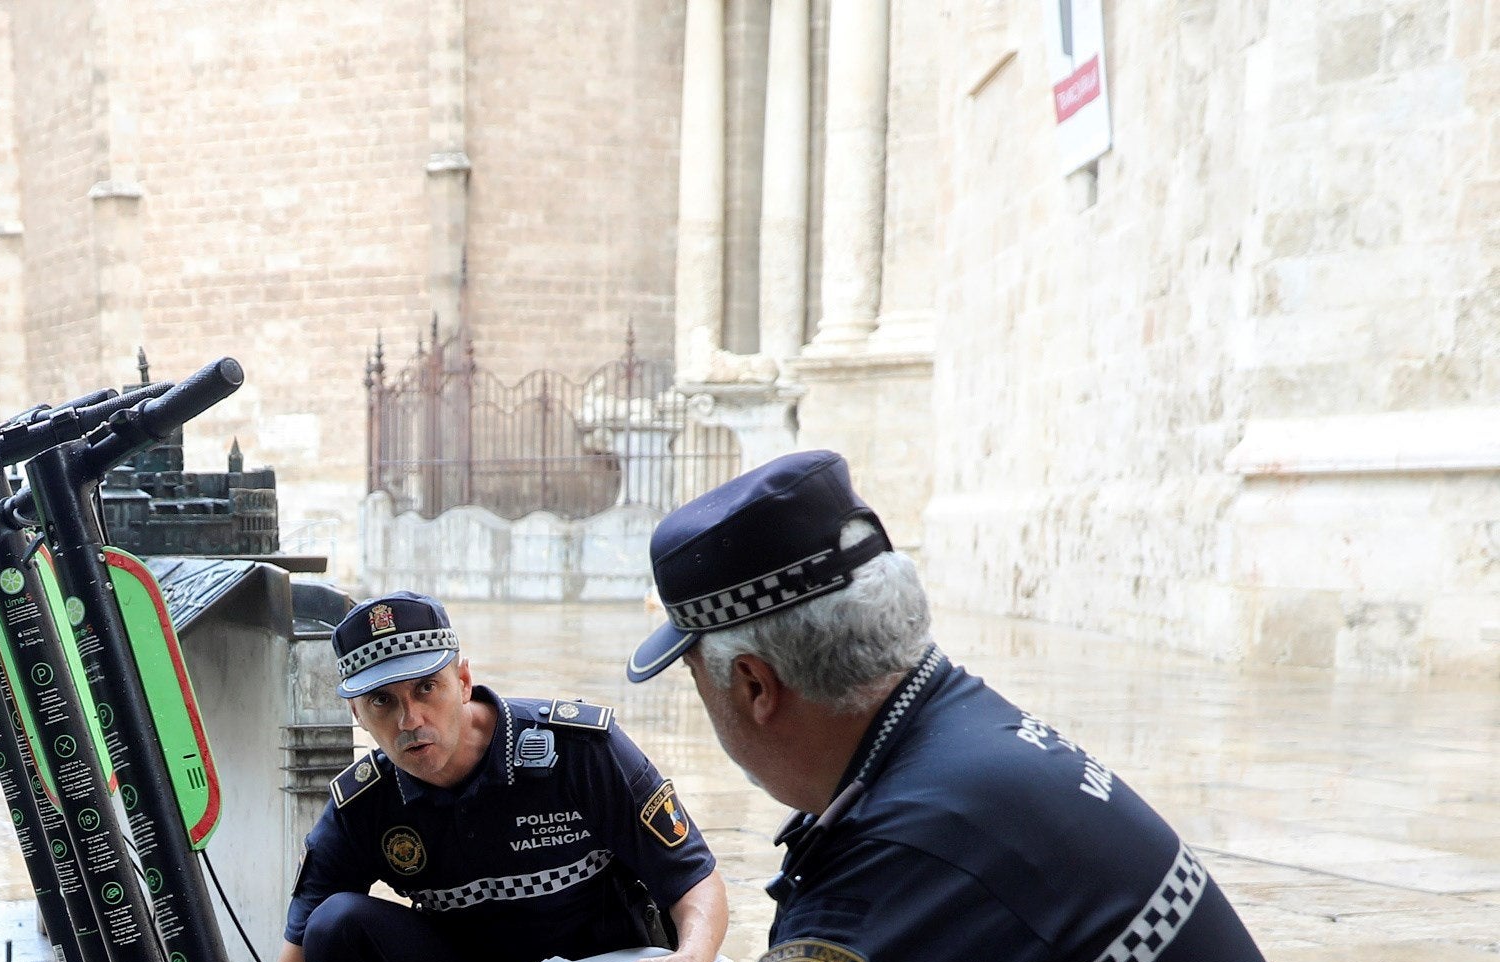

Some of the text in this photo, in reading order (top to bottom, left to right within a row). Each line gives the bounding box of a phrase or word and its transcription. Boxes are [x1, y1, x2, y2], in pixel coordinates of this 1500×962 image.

[36, 668, 47, 681] P
[80, 814, 96, 826] 18+
[516, 811, 582, 827] POLICIA
[532, 824, 571, 835] LOCAL
[510, 830, 591, 851] VALENCIA
